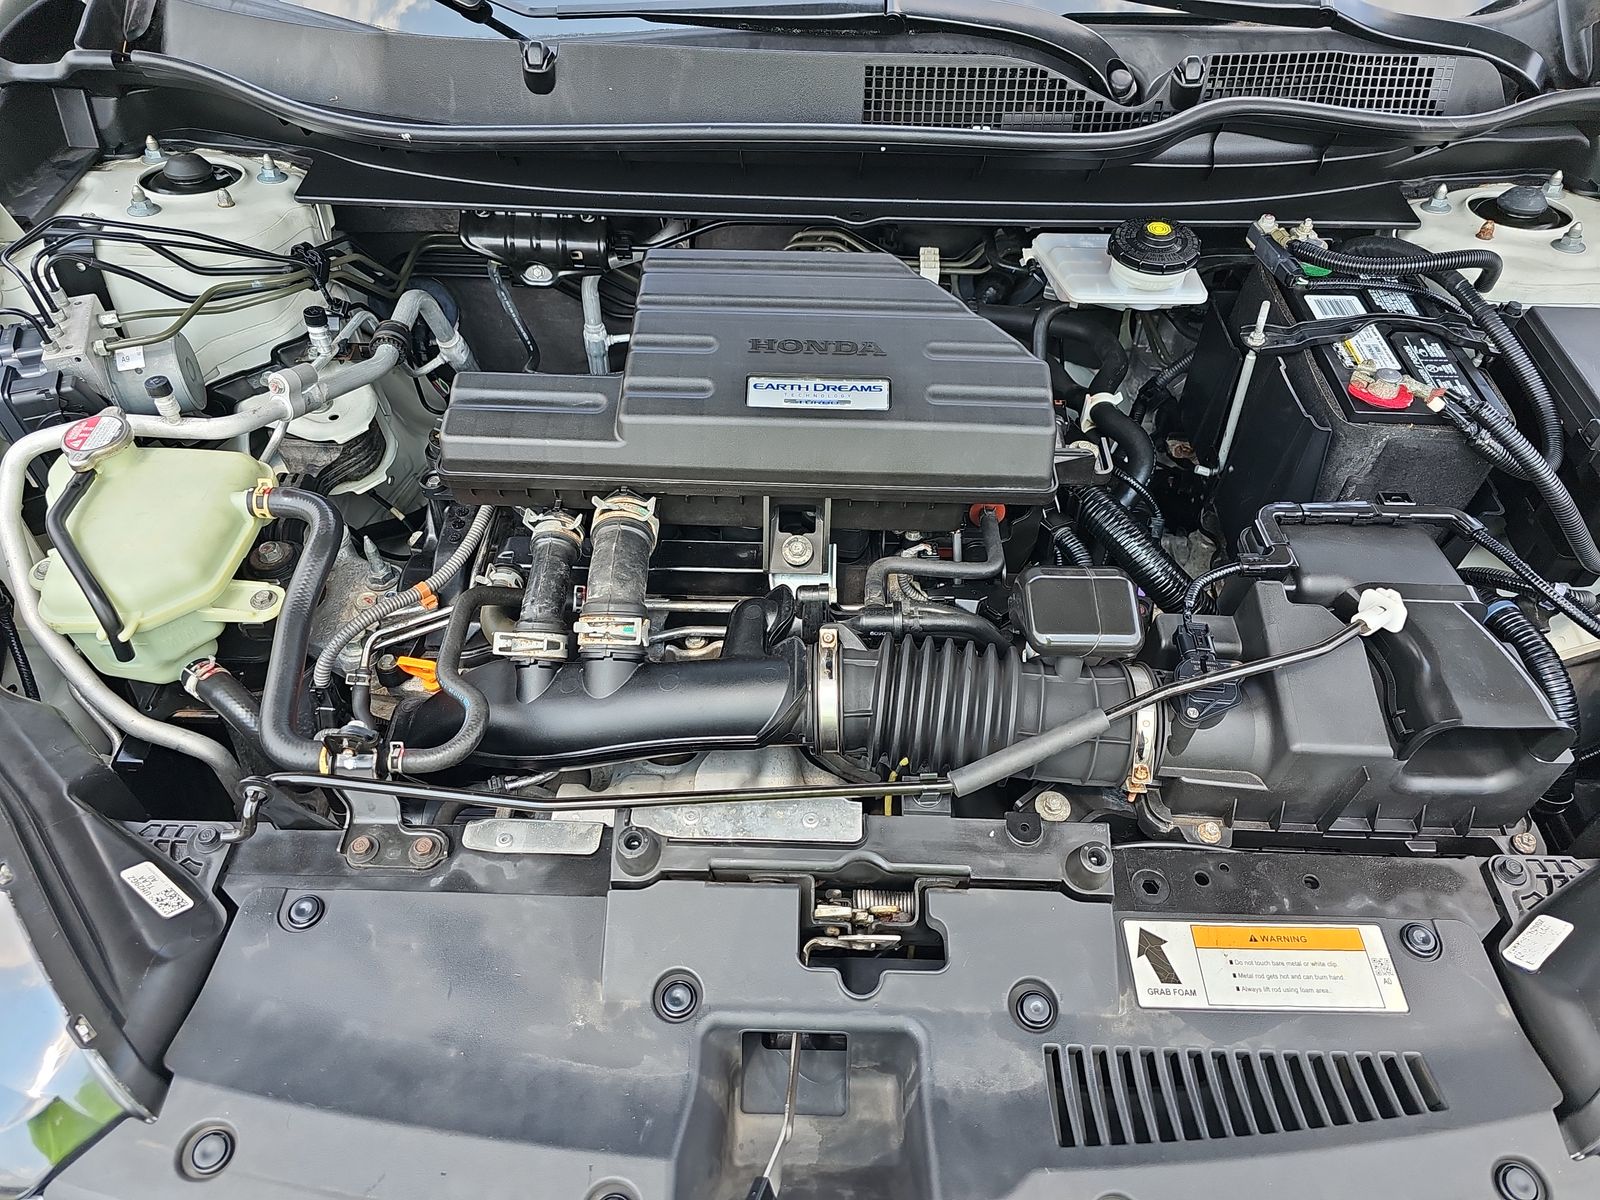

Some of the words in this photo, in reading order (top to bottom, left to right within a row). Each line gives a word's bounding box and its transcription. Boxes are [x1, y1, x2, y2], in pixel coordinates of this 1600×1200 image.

[748, 338, 887, 357] HONDA
[753, 383, 809, 392] EARTH
[1259, 935, 1308, 943] WARNING
[1266, 973, 1279, 981] gets
[1147, 987, 1171, 996] GRAB
[1173, 988, 1197, 997] FOAM
[1241, 985, 1262, 994] Always
[1283, 986, 1299, 994] using
